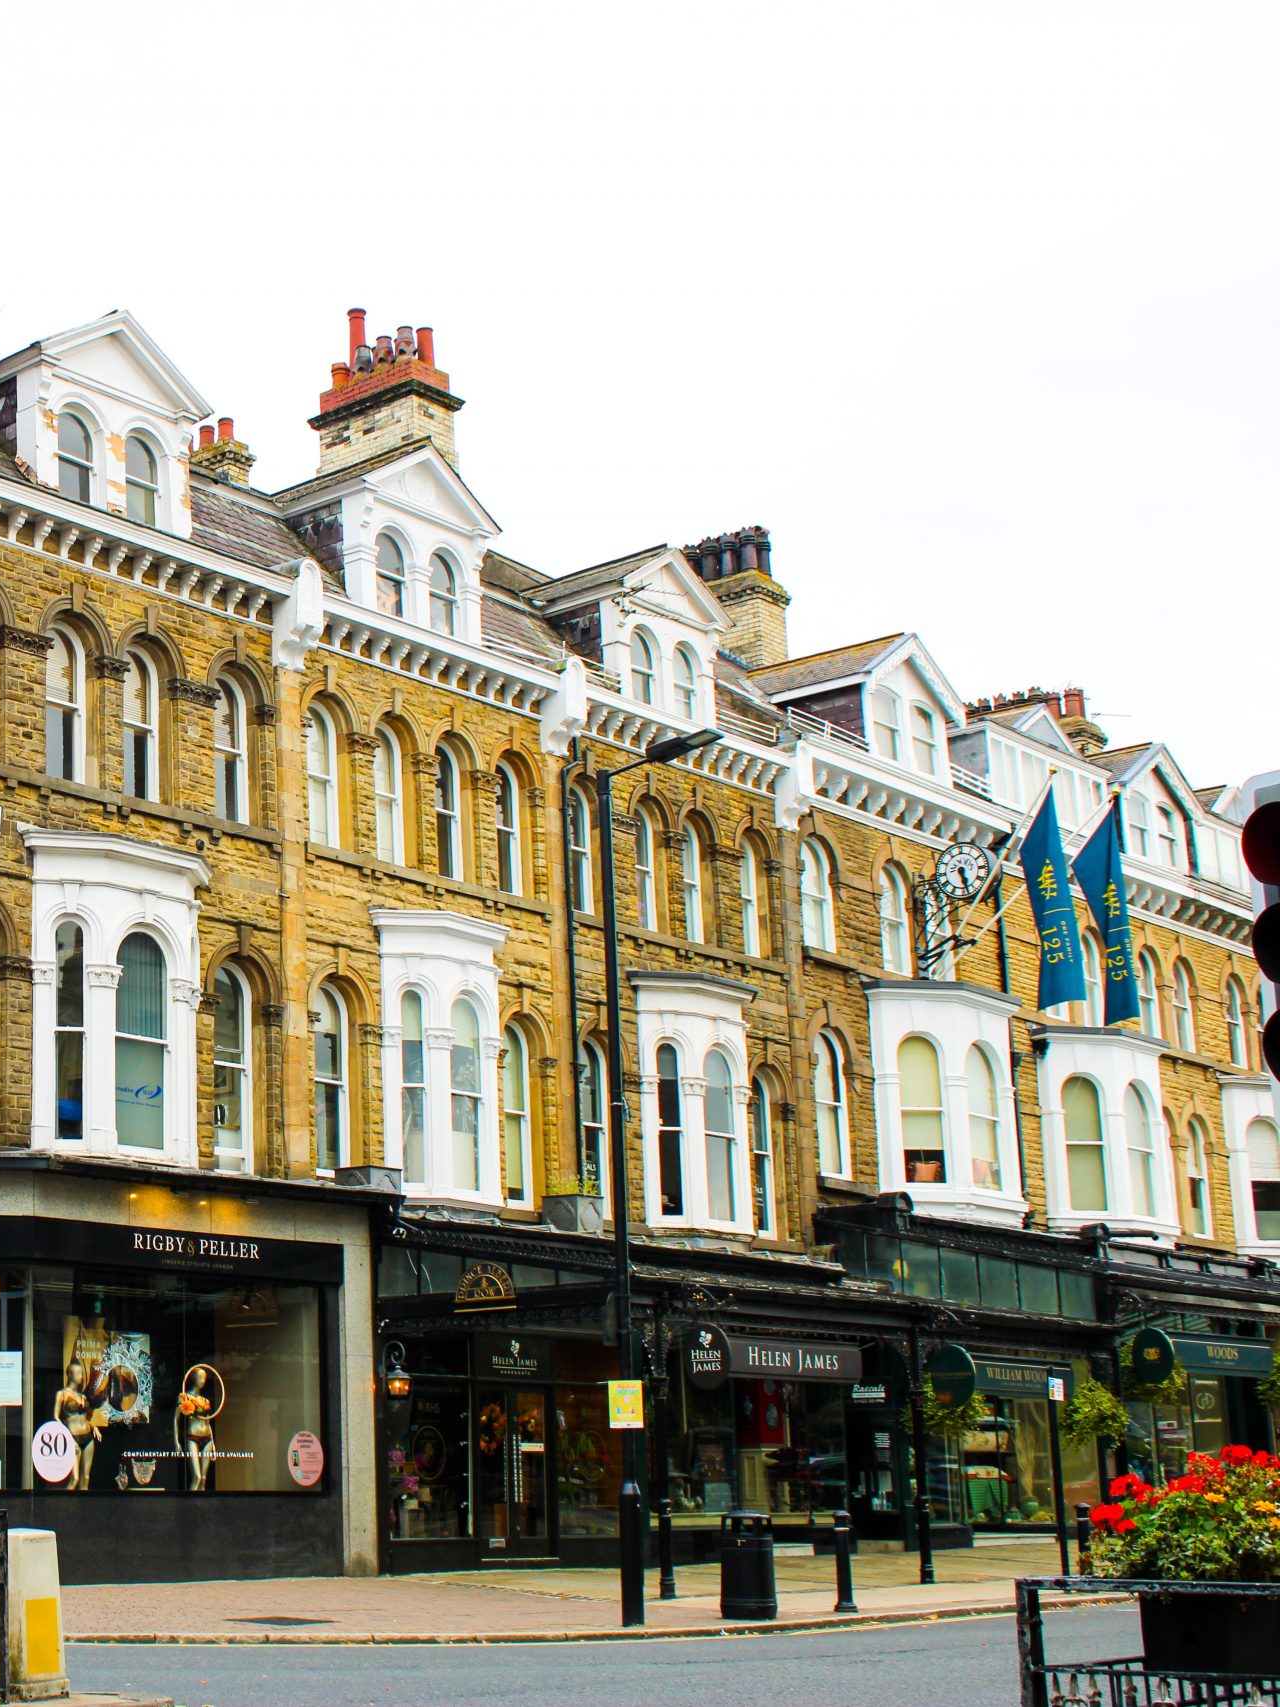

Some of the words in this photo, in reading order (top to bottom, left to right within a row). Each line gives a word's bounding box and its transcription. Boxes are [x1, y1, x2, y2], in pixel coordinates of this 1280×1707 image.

[1060, 920, 1069, 935] ONE
[1041, 926, 1065, 964] 125
[1106, 944, 1129, 981] 125
[133, 1232, 186, 1253] RIGBY
[199, 1238, 260, 1260] PELLER
[474, 1288, 497, 1298] ROW
[76, 1339, 102, 1349] PRIMA
[75, 1350, 103, 1359] DONNA
[691, 1349, 721, 1360] HELEN
[748, 1346, 791, 1367] HELEN
[797, 1349, 839, 1373] JAMES
[1206, 1345, 1239, 1360] WOODS
[492, 1355, 515, 1366] HELEN
[517, 1357, 538, 1367] JAMES
[693, 1361, 721, 1374] JAMES
[986, 1366, 1023, 1381] WILLIAM
[1023, 1370, 1048, 1383] WOO
[40, 1431, 68, 1458] 80
